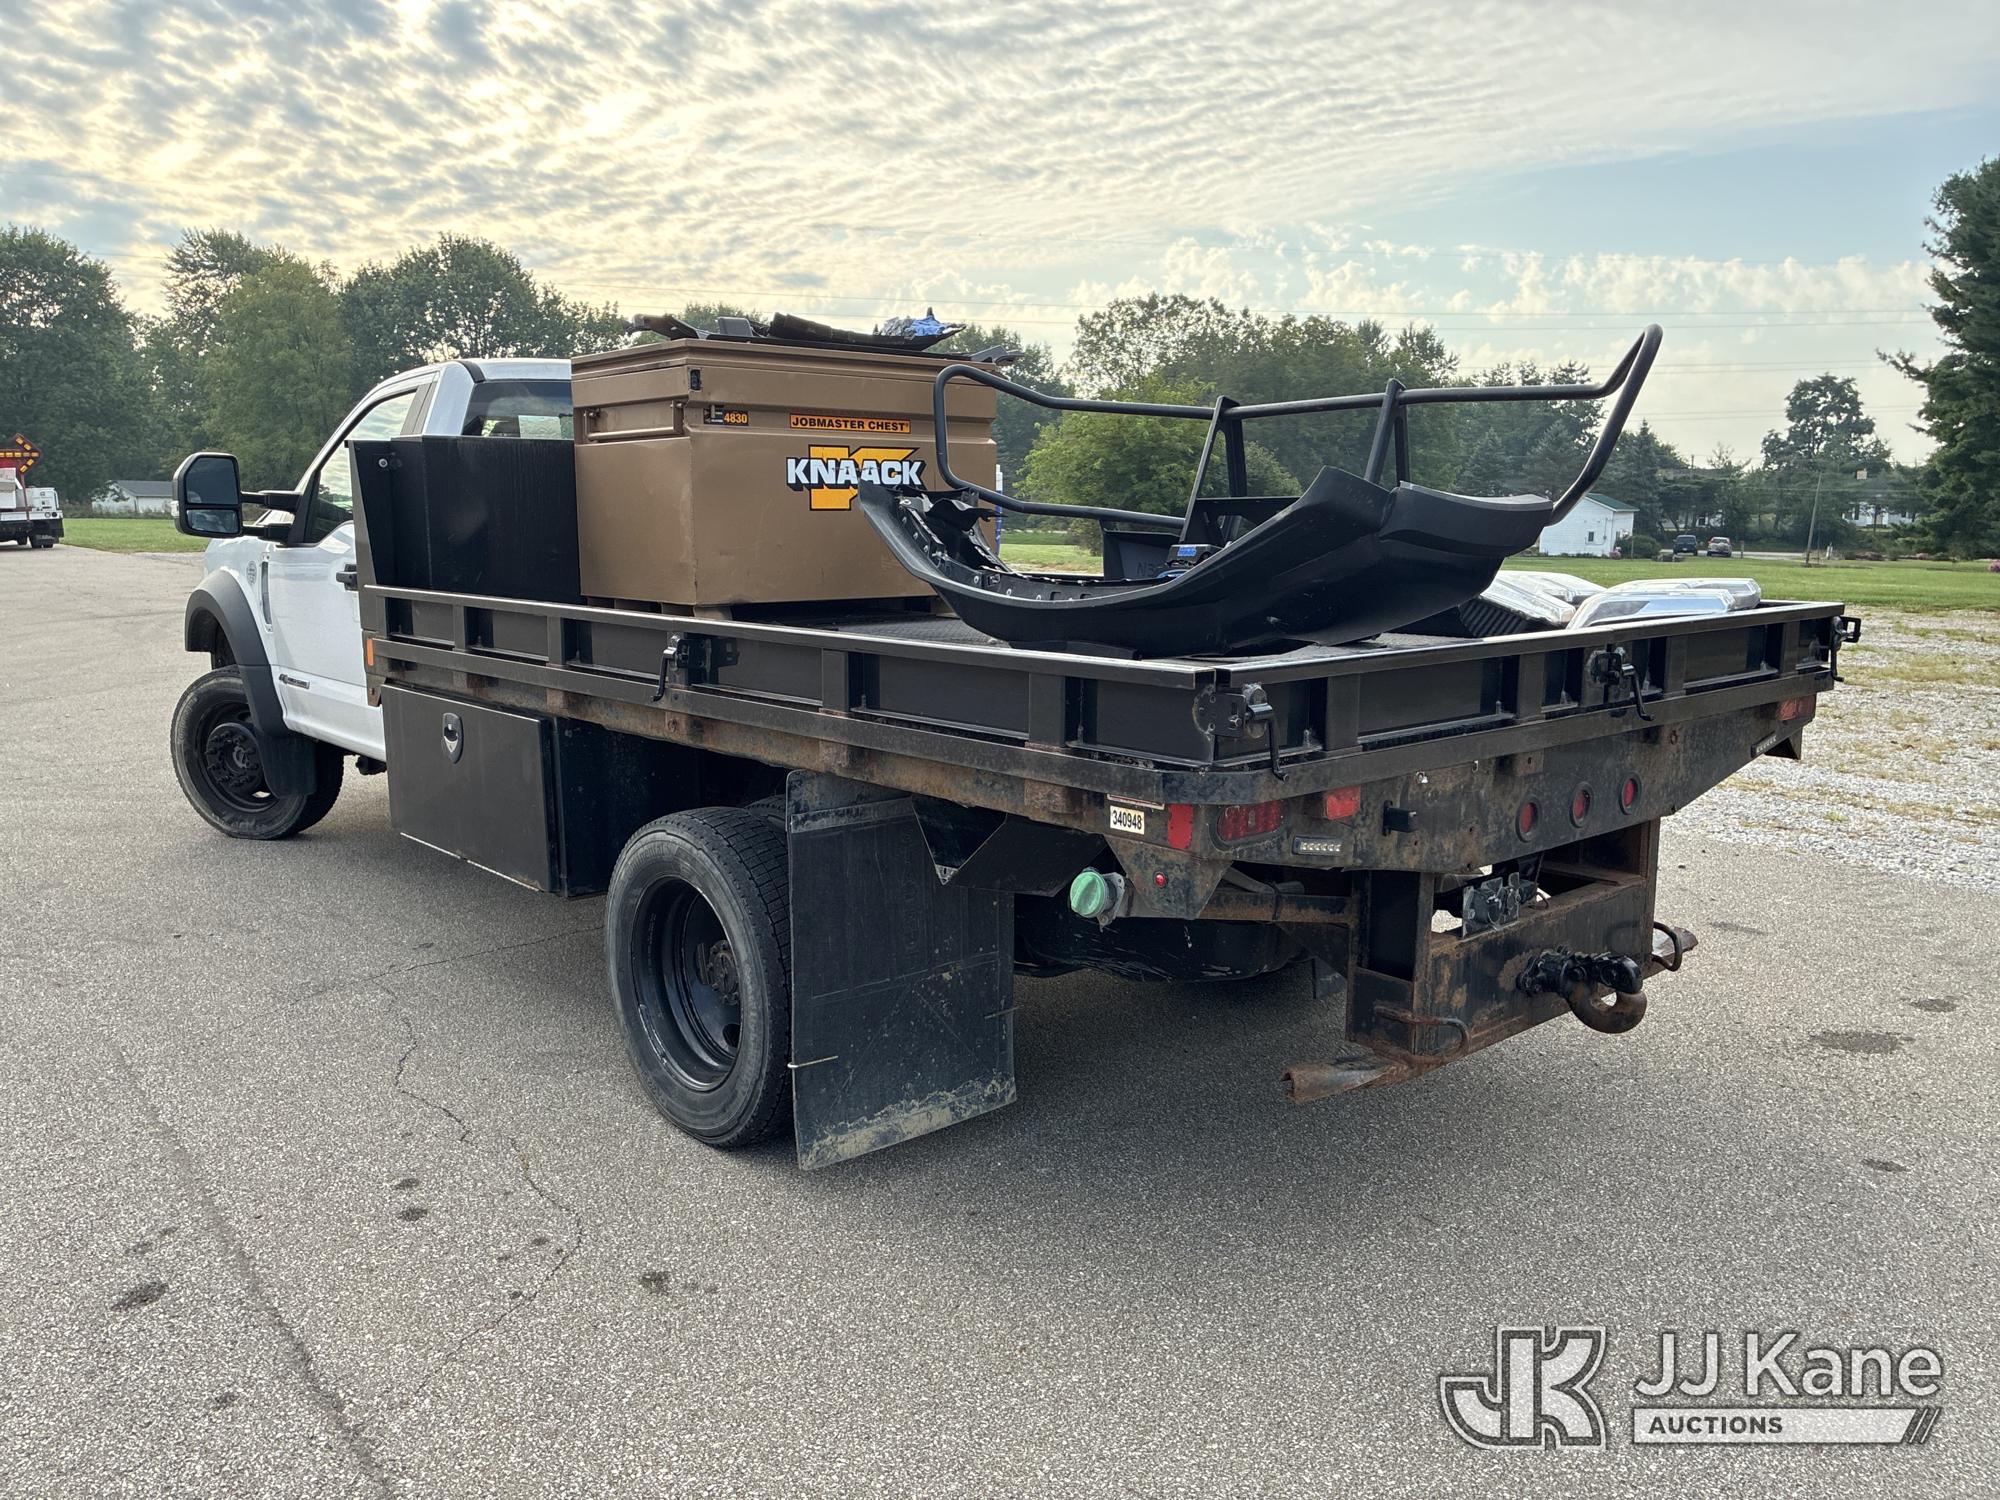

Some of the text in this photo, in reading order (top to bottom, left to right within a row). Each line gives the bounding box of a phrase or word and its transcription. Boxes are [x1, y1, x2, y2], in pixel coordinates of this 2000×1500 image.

[723, 412, 748, 424] 4830
[791, 416, 865, 430] JOBMASTER
[786, 457, 925, 489] KNAACK
[1112, 809, 1143, 831] 340948
